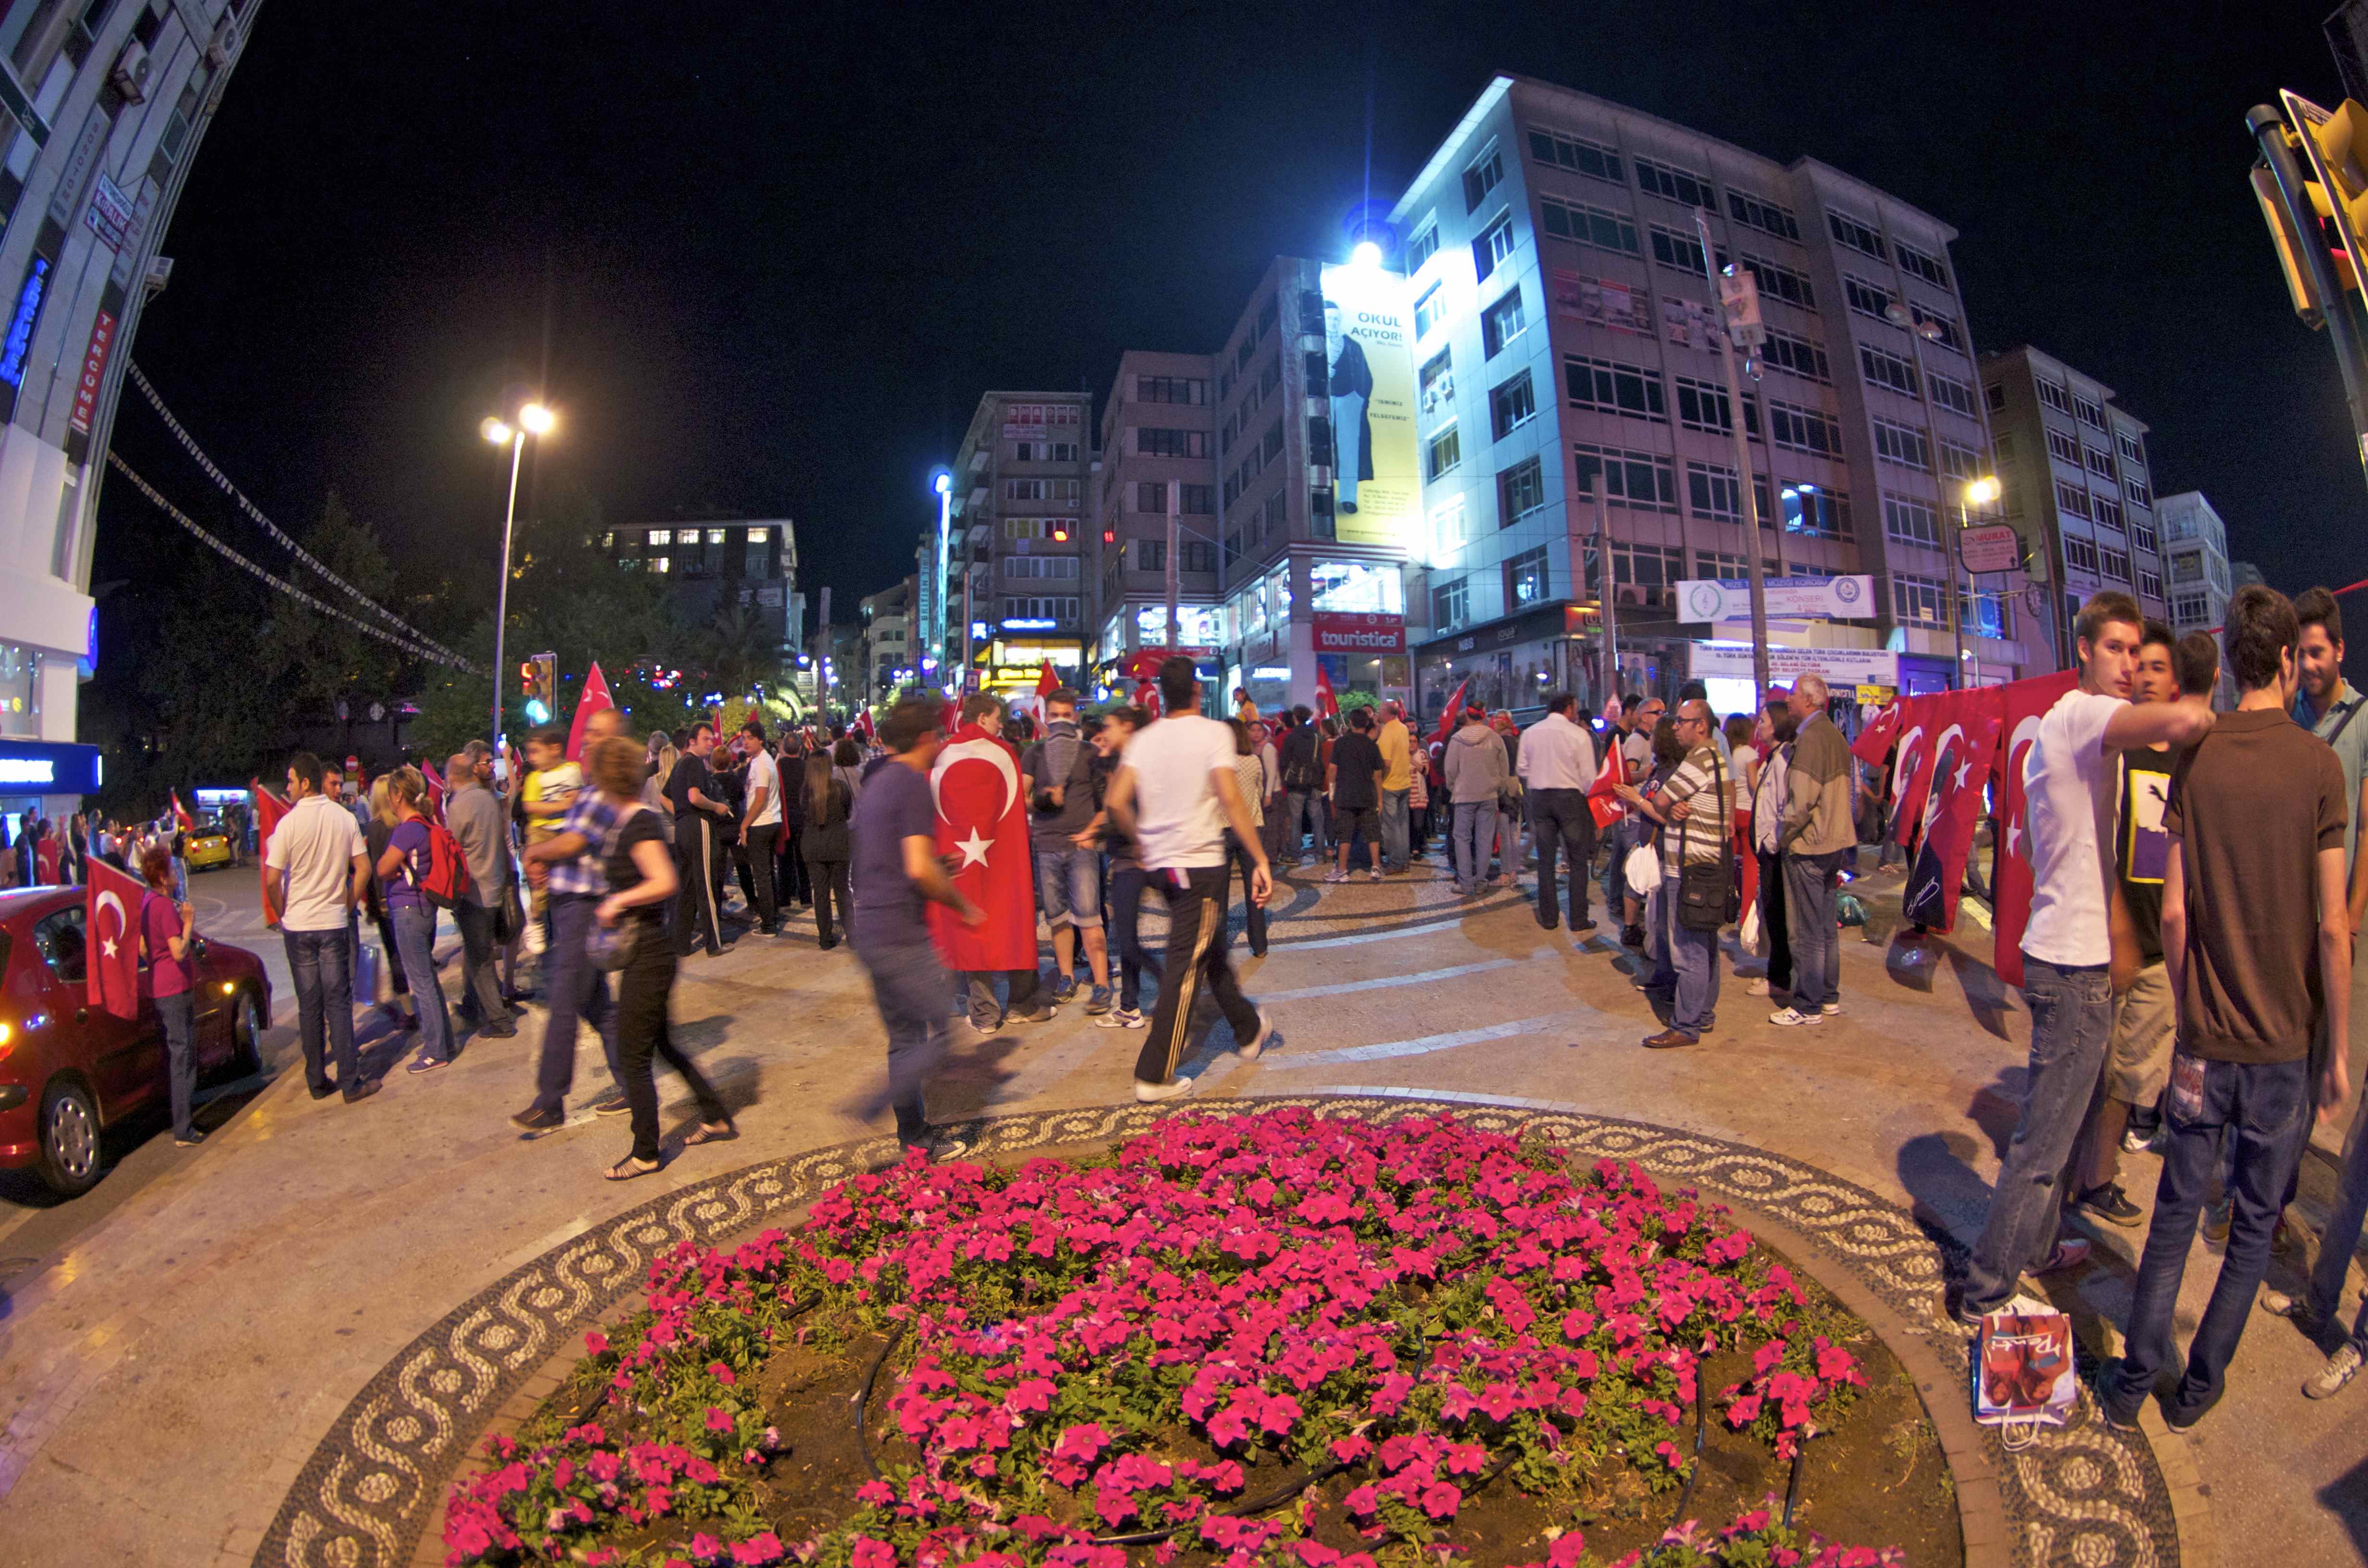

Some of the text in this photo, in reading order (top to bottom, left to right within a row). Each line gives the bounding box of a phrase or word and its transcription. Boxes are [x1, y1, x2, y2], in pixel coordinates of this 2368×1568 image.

[1358, 312, 1402, 327] OKUL
[1351, 326, 1402, 342] AÇIYOR!
[1975, 530, 2011, 541] MURAT
[1786, 594, 1824, 603] KONSERİ
[1322, 630, 1398, 647] touristica
